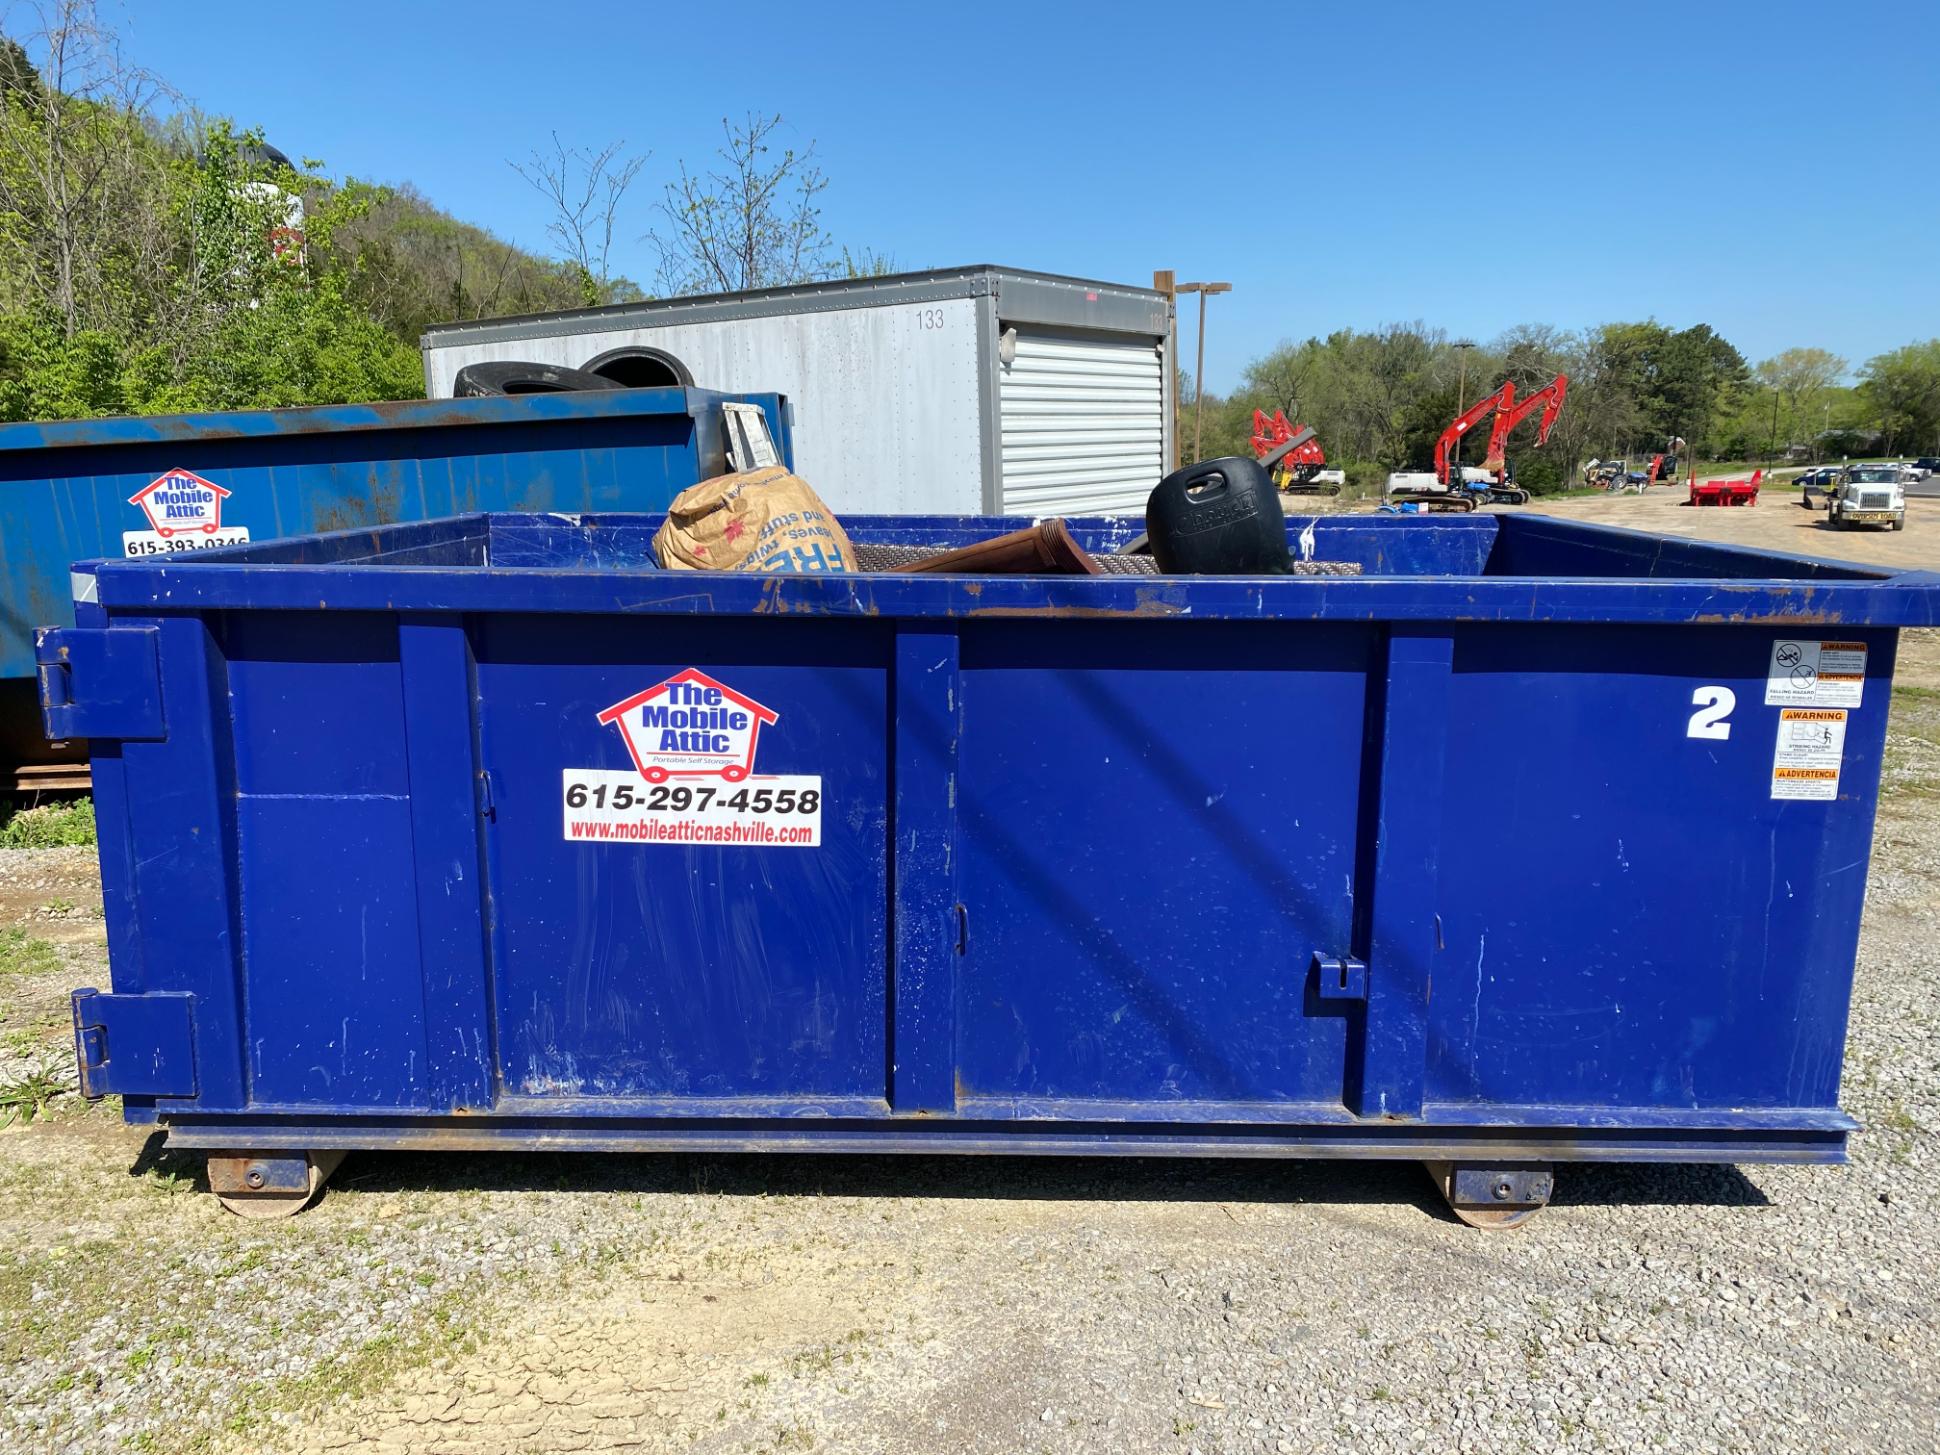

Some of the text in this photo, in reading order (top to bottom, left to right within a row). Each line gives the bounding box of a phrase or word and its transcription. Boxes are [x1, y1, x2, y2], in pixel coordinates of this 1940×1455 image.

[915, 309, 944, 330] 133
[164, 476, 197, 491] The
[153, 490, 213, 505] Mobile
[165, 503, 205, 518] Attic
[664, 682, 723, 706] The
[642, 705, 748, 731] Mobile
[1686, 685, 1736, 740] 2
[1793, 712, 1843, 720] WARNING
[658, 729, 730, 754] Attic
[652, 755, 687, 764] Portable
[704, 758, 735, 766] Storage
[1786, 769, 1837, 778] ADVERTENCIA
[566, 783, 820, 815] 615-297-4558
[571, 818, 813, 843] www.mobileatticnashville.com
